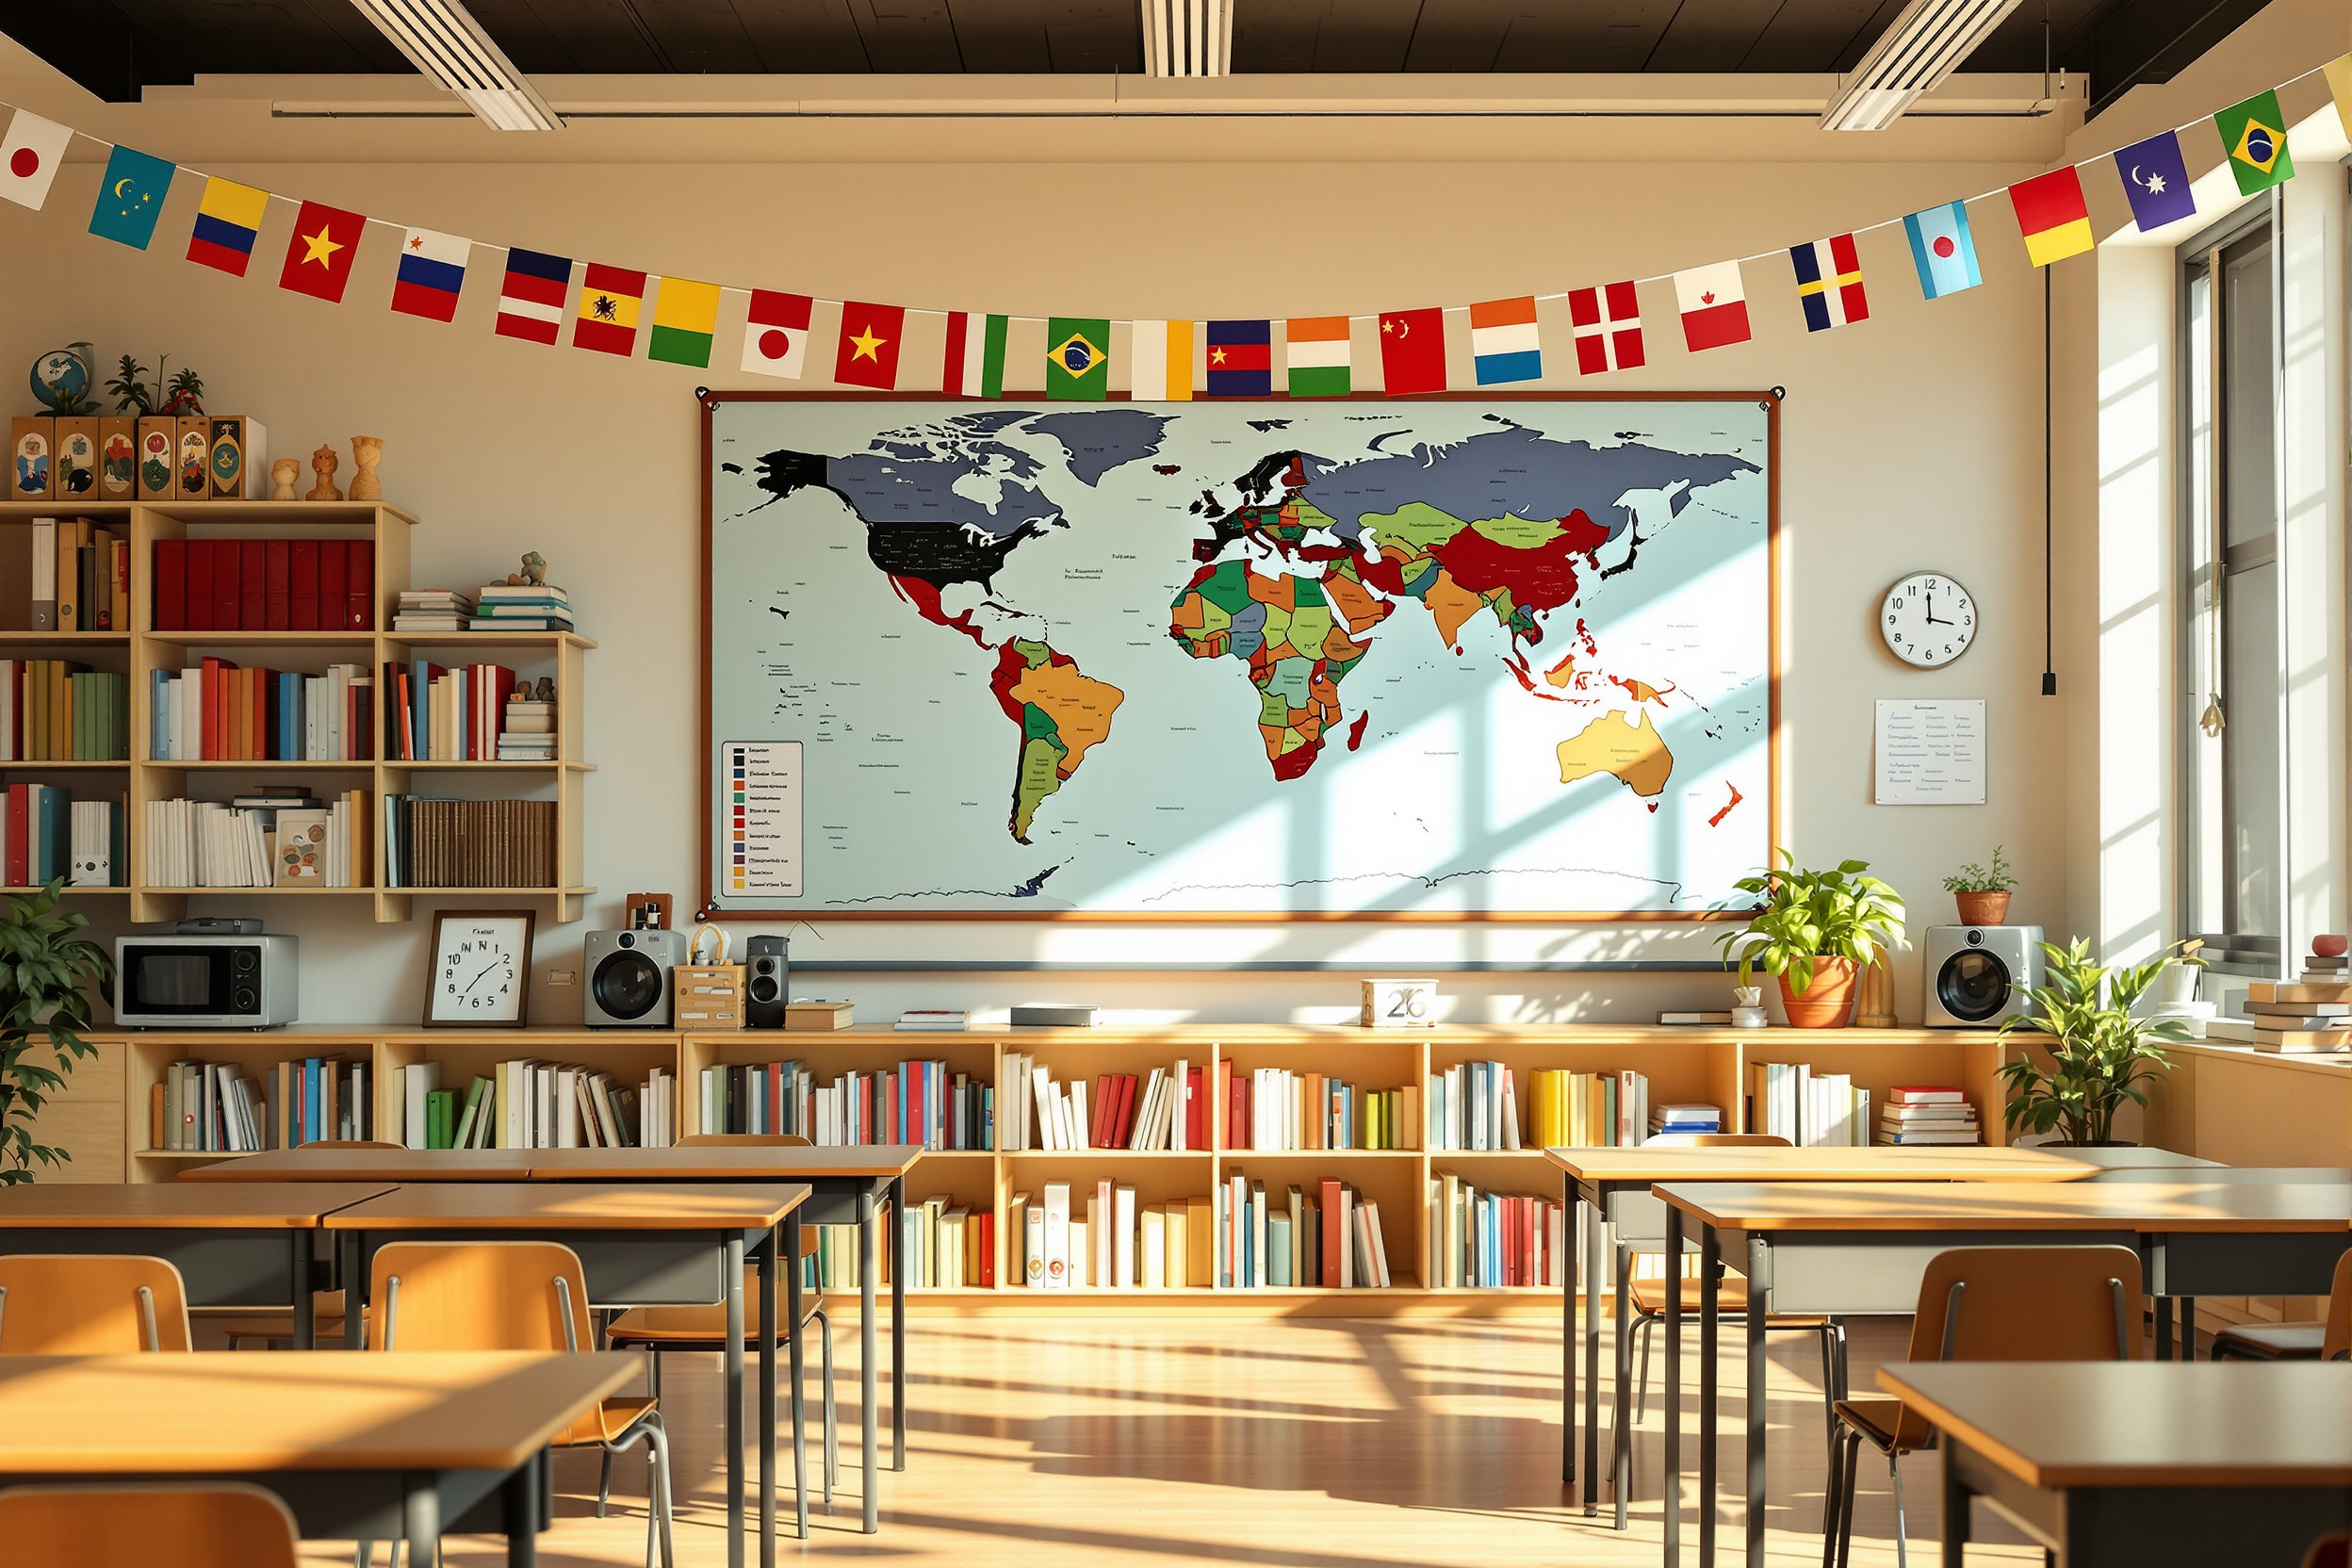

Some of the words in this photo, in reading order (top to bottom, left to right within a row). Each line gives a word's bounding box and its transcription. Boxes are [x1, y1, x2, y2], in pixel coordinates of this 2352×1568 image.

[1925, 580, 1936, 589] 12
[1908, 585, 1916, 596] 11
[1947, 586, 1951, 596] 1
[1892, 598, 1903, 609] 10
[1959, 598, 1966, 609] 2
[1964, 615, 1970, 625] 3
[1894, 633, 1902, 642] 8
[1958, 634, 1965, 643] 4
[1907, 645, 1914, 655] 7
[1945, 645, 1952, 653] 5
[1925, 649, 1933, 660] 6
[503, 954, 510, 964] 2
[506, 970, 513, 979] 3
[449, 984, 455, 993] 8
[500, 984, 508, 993] 4
[458, 996, 465, 1005] 7
[472, 998, 479, 1007] 6
[487, 996, 494, 1005] 5
[1387, 988, 1427, 1018] 26
